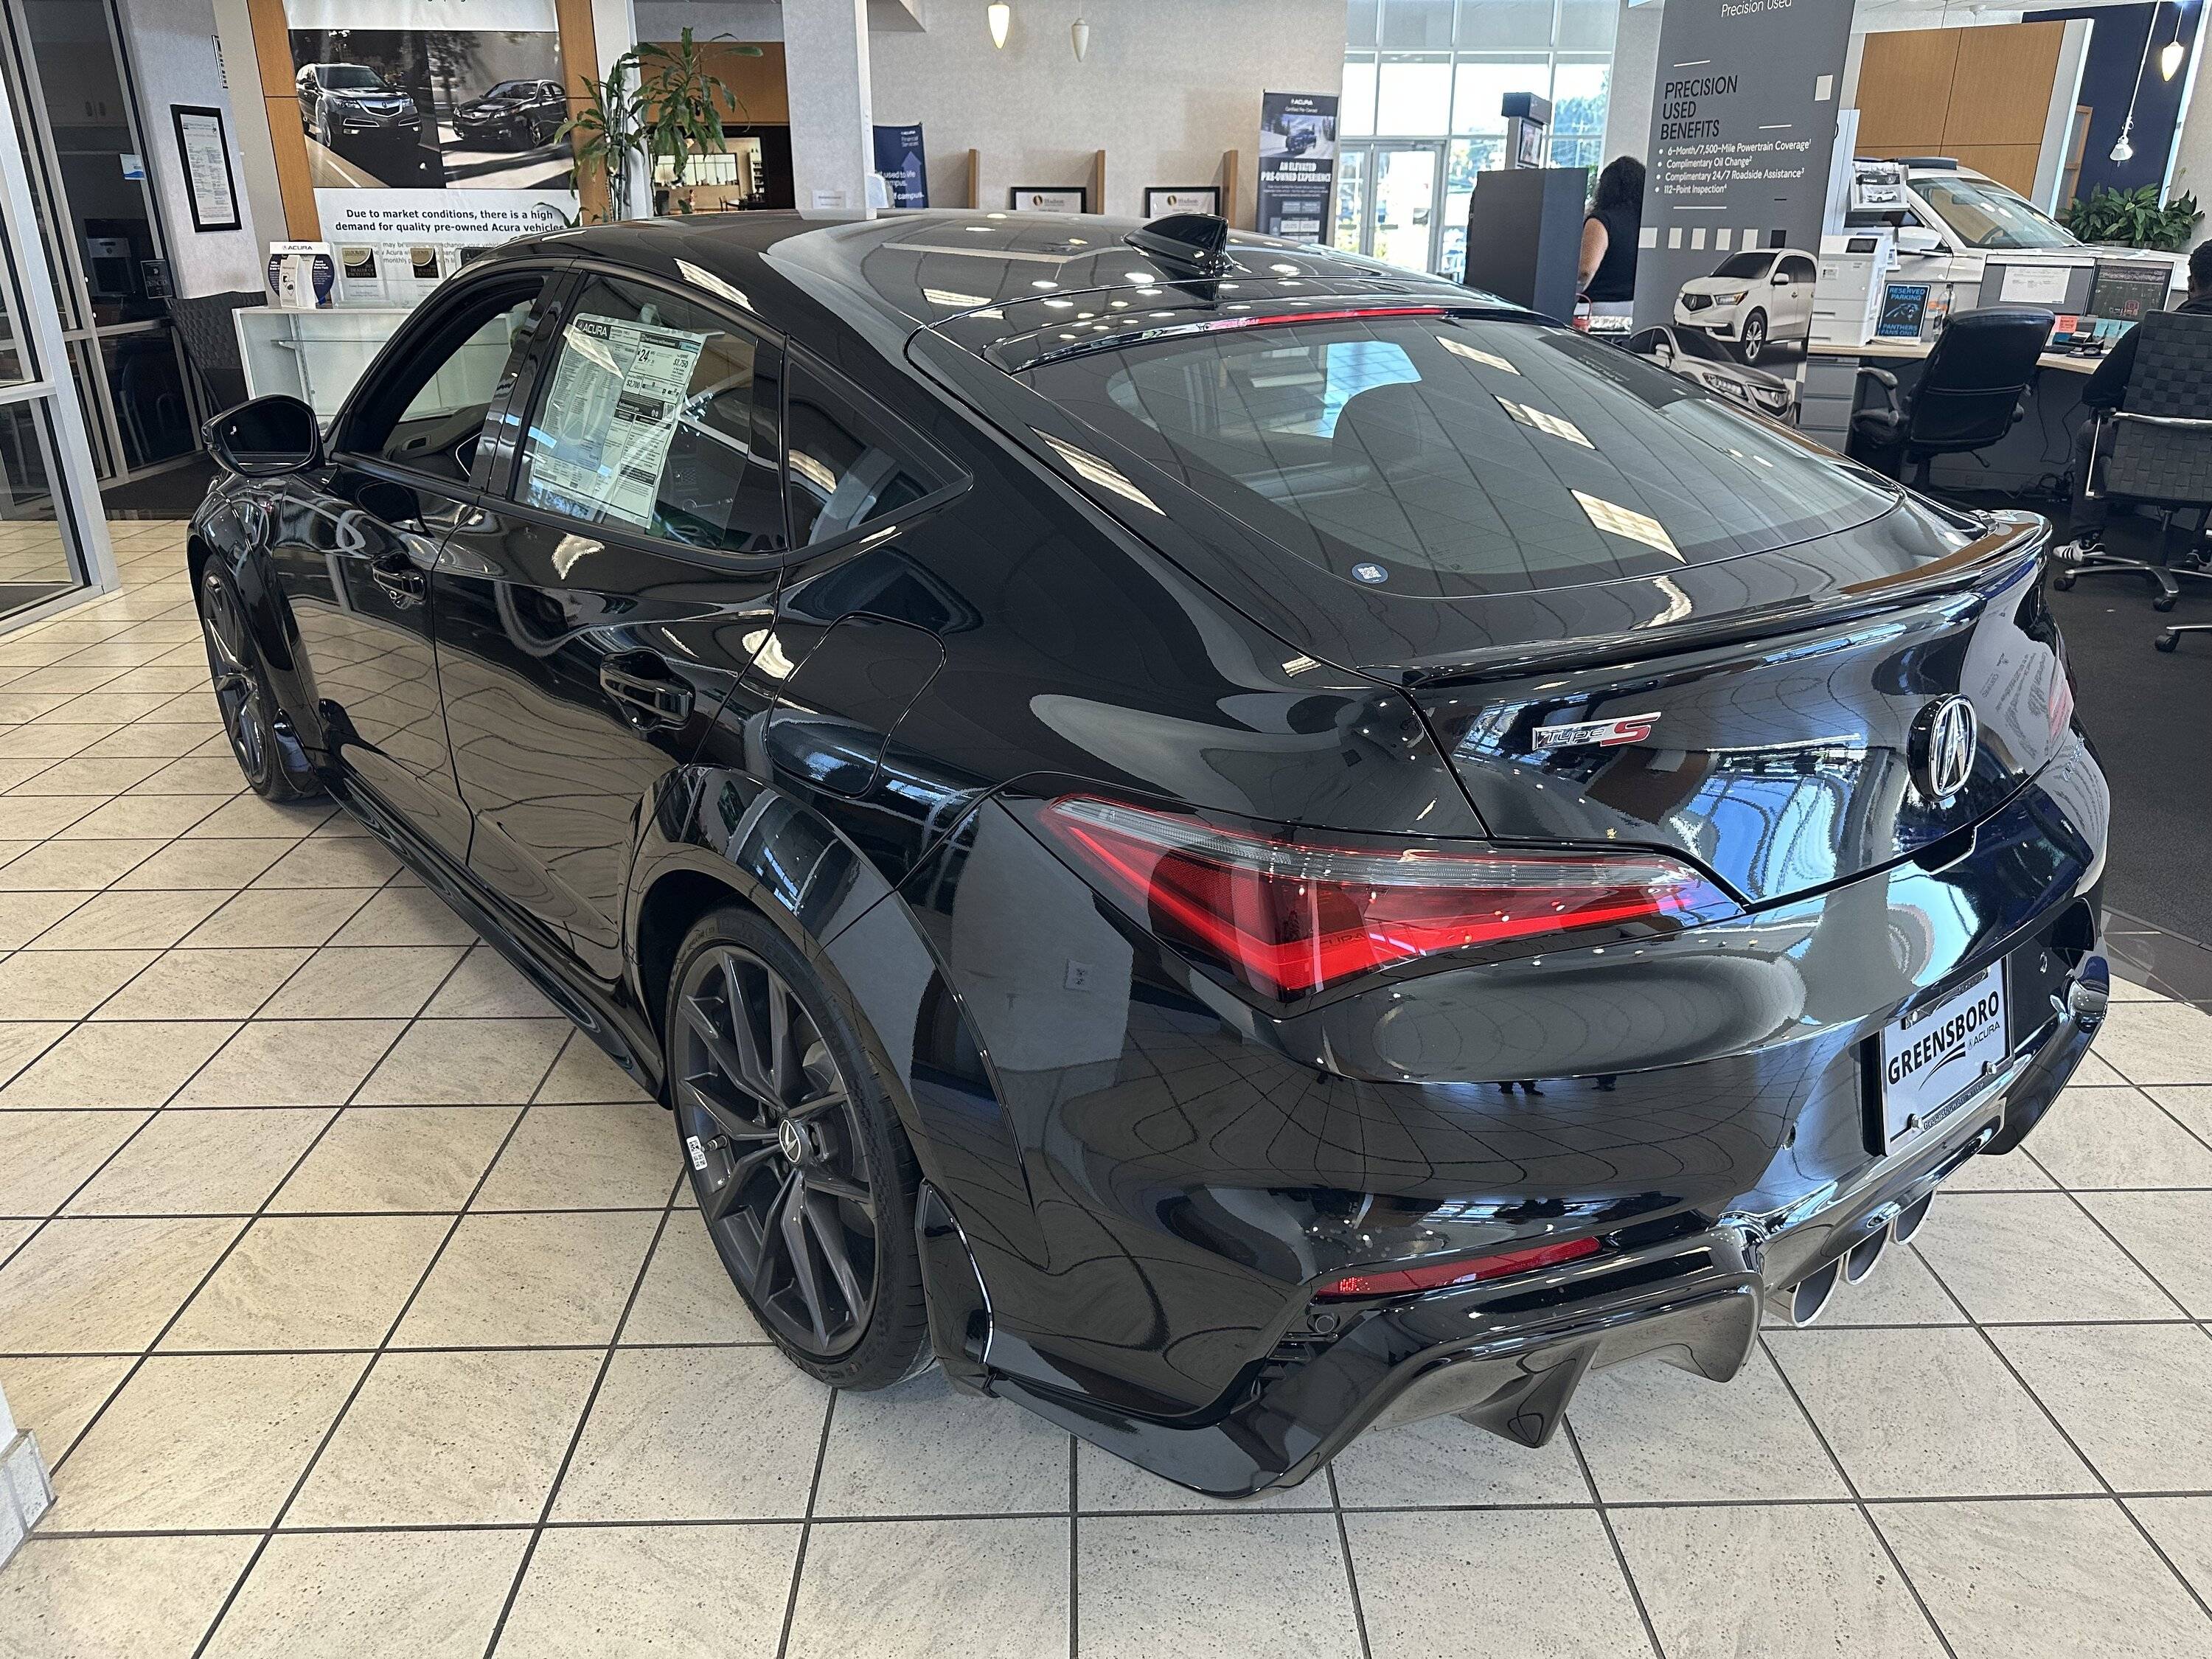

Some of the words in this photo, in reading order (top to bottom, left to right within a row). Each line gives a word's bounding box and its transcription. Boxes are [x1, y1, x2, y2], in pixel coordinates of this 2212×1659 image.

[1721, 0, 1764, 17] Precision
[1664, 75, 1738, 100] PRECISION
[1663, 101, 1697, 120] USED
[1660, 119, 1719, 140] BENEFITS
[1668, 143, 1736, 156] 6-Month/7,500-Mile
[1736, 142, 1773, 152] Powertrain
[1666, 159, 1713, 170] Complimentary
[1714, 158, 1724, 167] Oil
[1665, 172, 1711, 183] Complimentary
[1712, 170, 1731, 181] 24/7
[1731, 170, 1762, 179] Roadside
[1664, 184, 1691, 195] 112-Point
[347, 209, 366, 218] Due
[369, 210, 380, 218] to
[383, 209, 419, 219] market
[422, 209, 478, 220] conditions,
[480, 209, 507, 219] there
[510, 209, 519, 220] is
[531, 209, 553, 221] high
[335, 223, 376, 232] demand
[378, 223, 394, 232] for
[396, 223, 431, 234] quality
[434, 223, 488, 233] pre-owned
[491, 223, 521, 232] Acura
[583, 323, 608, 337] ACURA
[639, 349, 650, 362] 24
[1600, 712, 1662, 748] S
[1888, 991, 2000, 1085] GREENSBORO
[1972, 1020, 2000, 1047] ACURA
